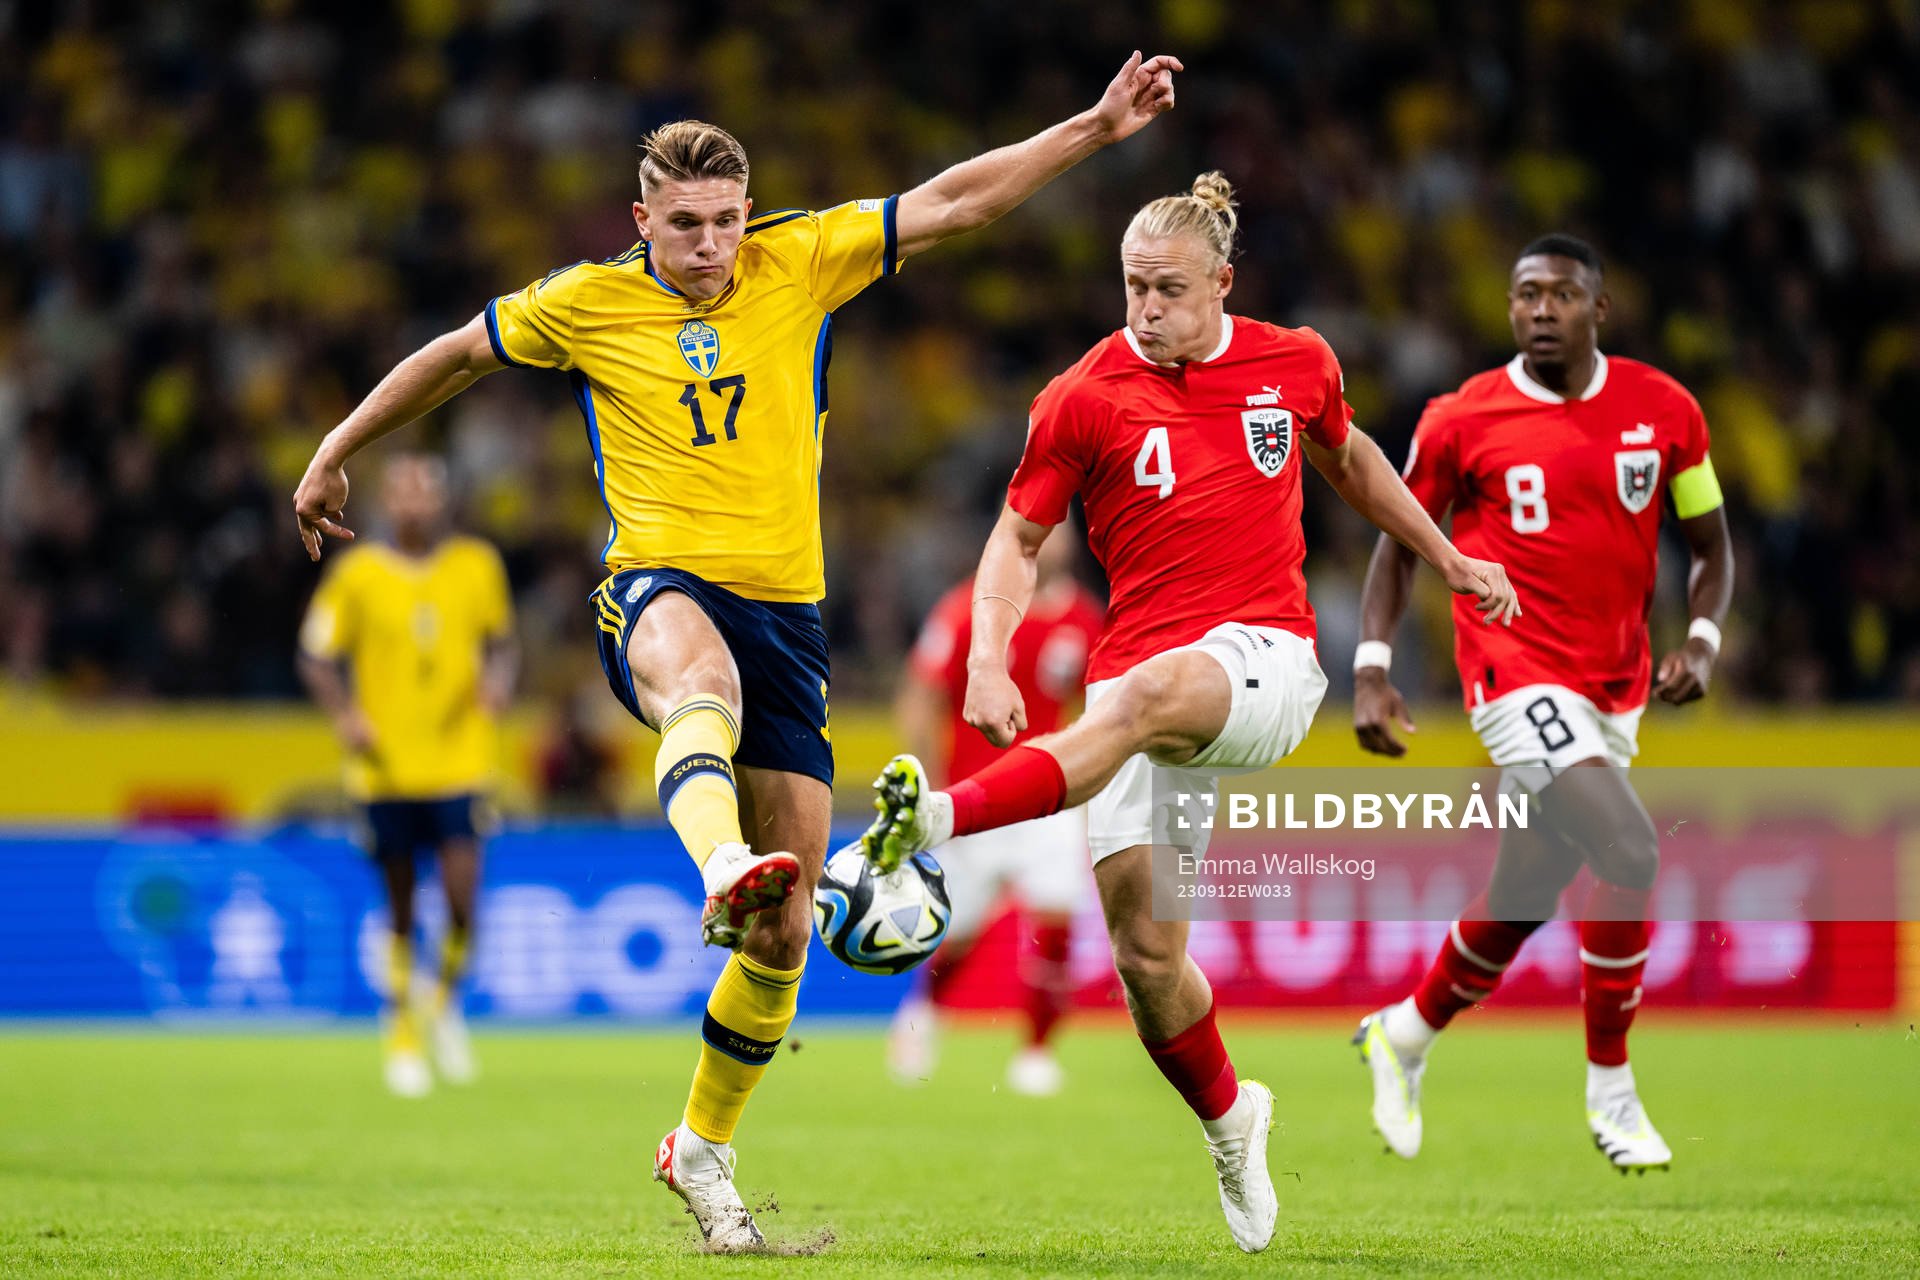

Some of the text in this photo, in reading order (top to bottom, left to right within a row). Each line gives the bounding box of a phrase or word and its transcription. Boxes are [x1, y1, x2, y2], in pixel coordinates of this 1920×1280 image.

[678, 374, 746, 447] 17
[1133, 426, 1176, 499] 4
[1505, 464, 1549, 534] 8
[1525, 696, 1575, 752] 8
